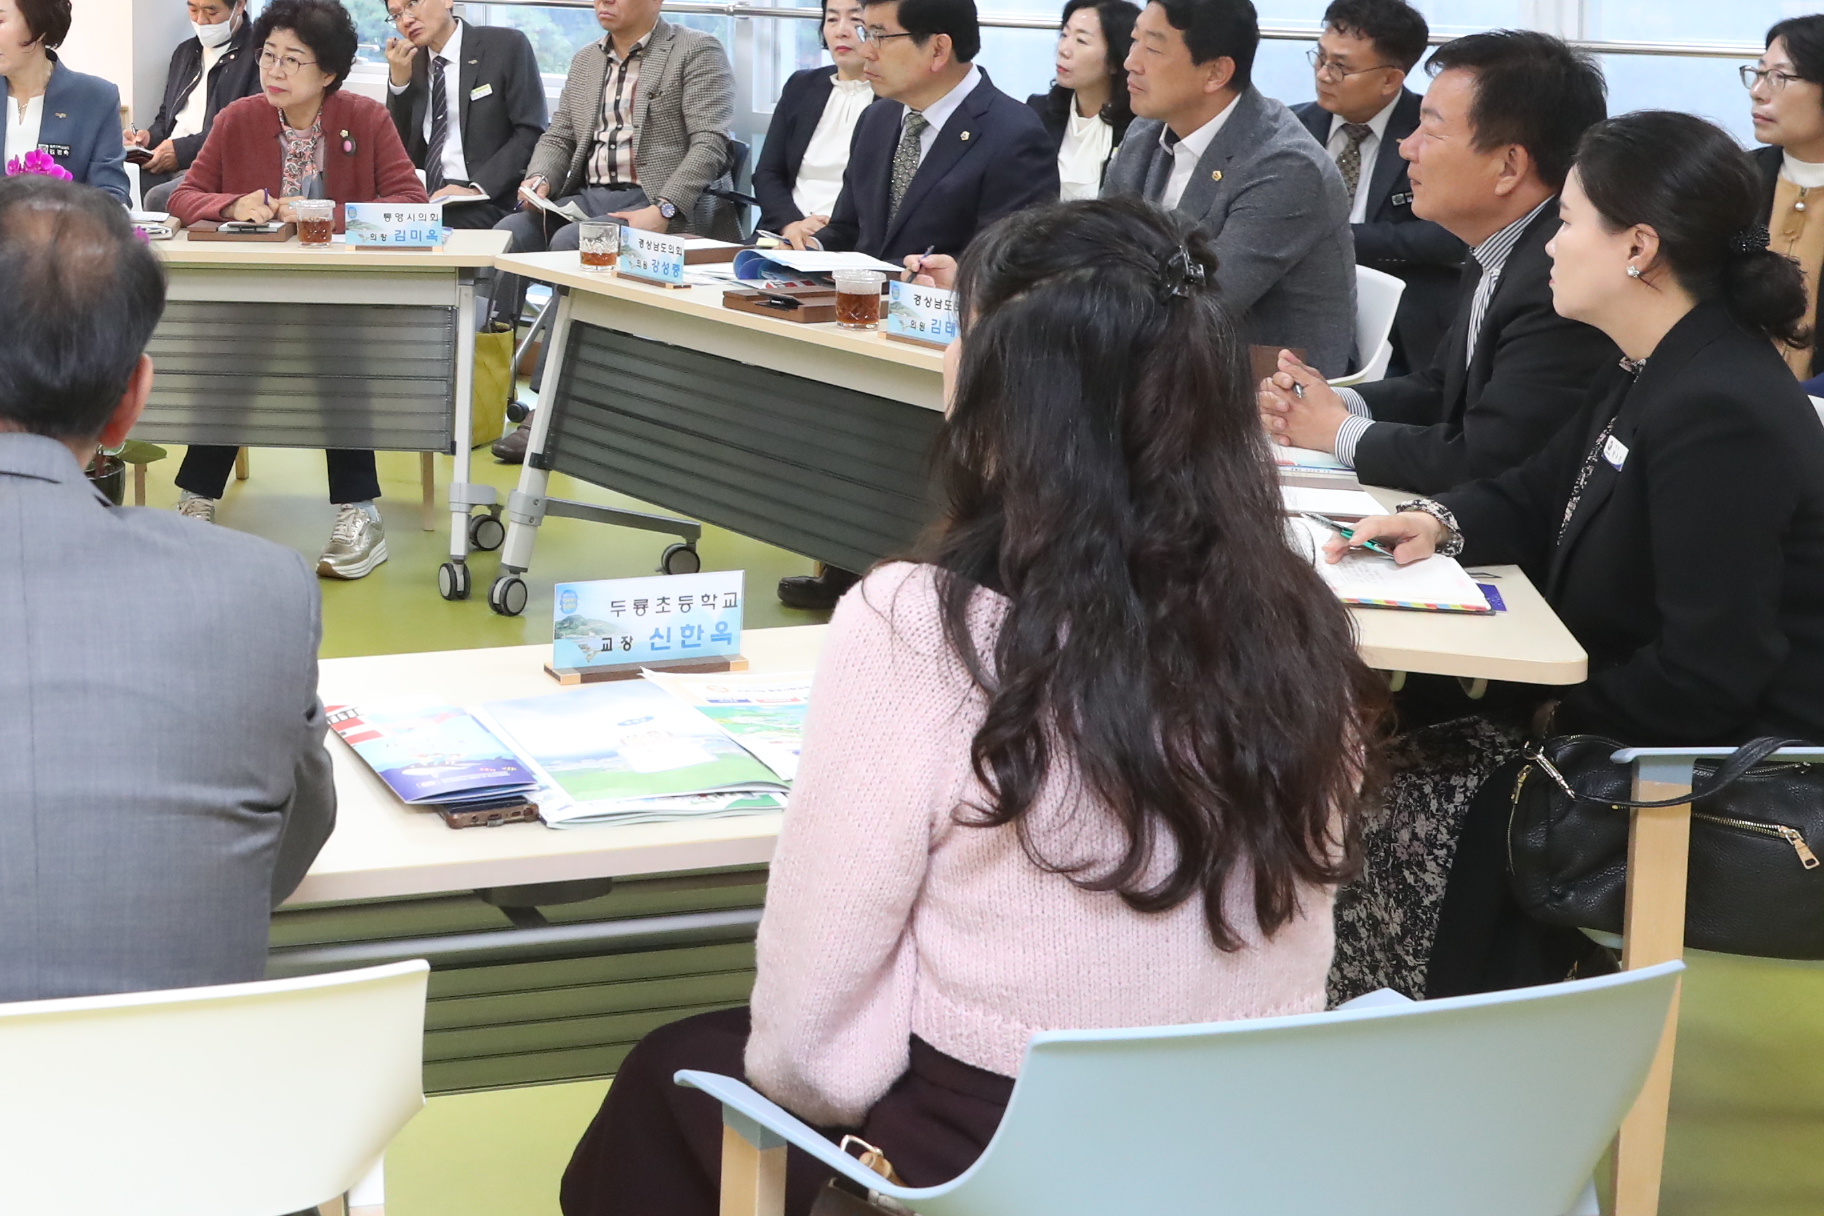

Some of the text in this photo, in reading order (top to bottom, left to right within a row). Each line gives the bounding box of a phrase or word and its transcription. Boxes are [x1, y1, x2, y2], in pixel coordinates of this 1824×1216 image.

[383, 212, 439, 223] 통영시의회
[369, 229, 439, 242] 의장 김미옥
[638, 237, 683, 257] 경상남도의회
[910, 319, 926, 332] 의원
[600, 620, 734, 652] 교장 신한옥
